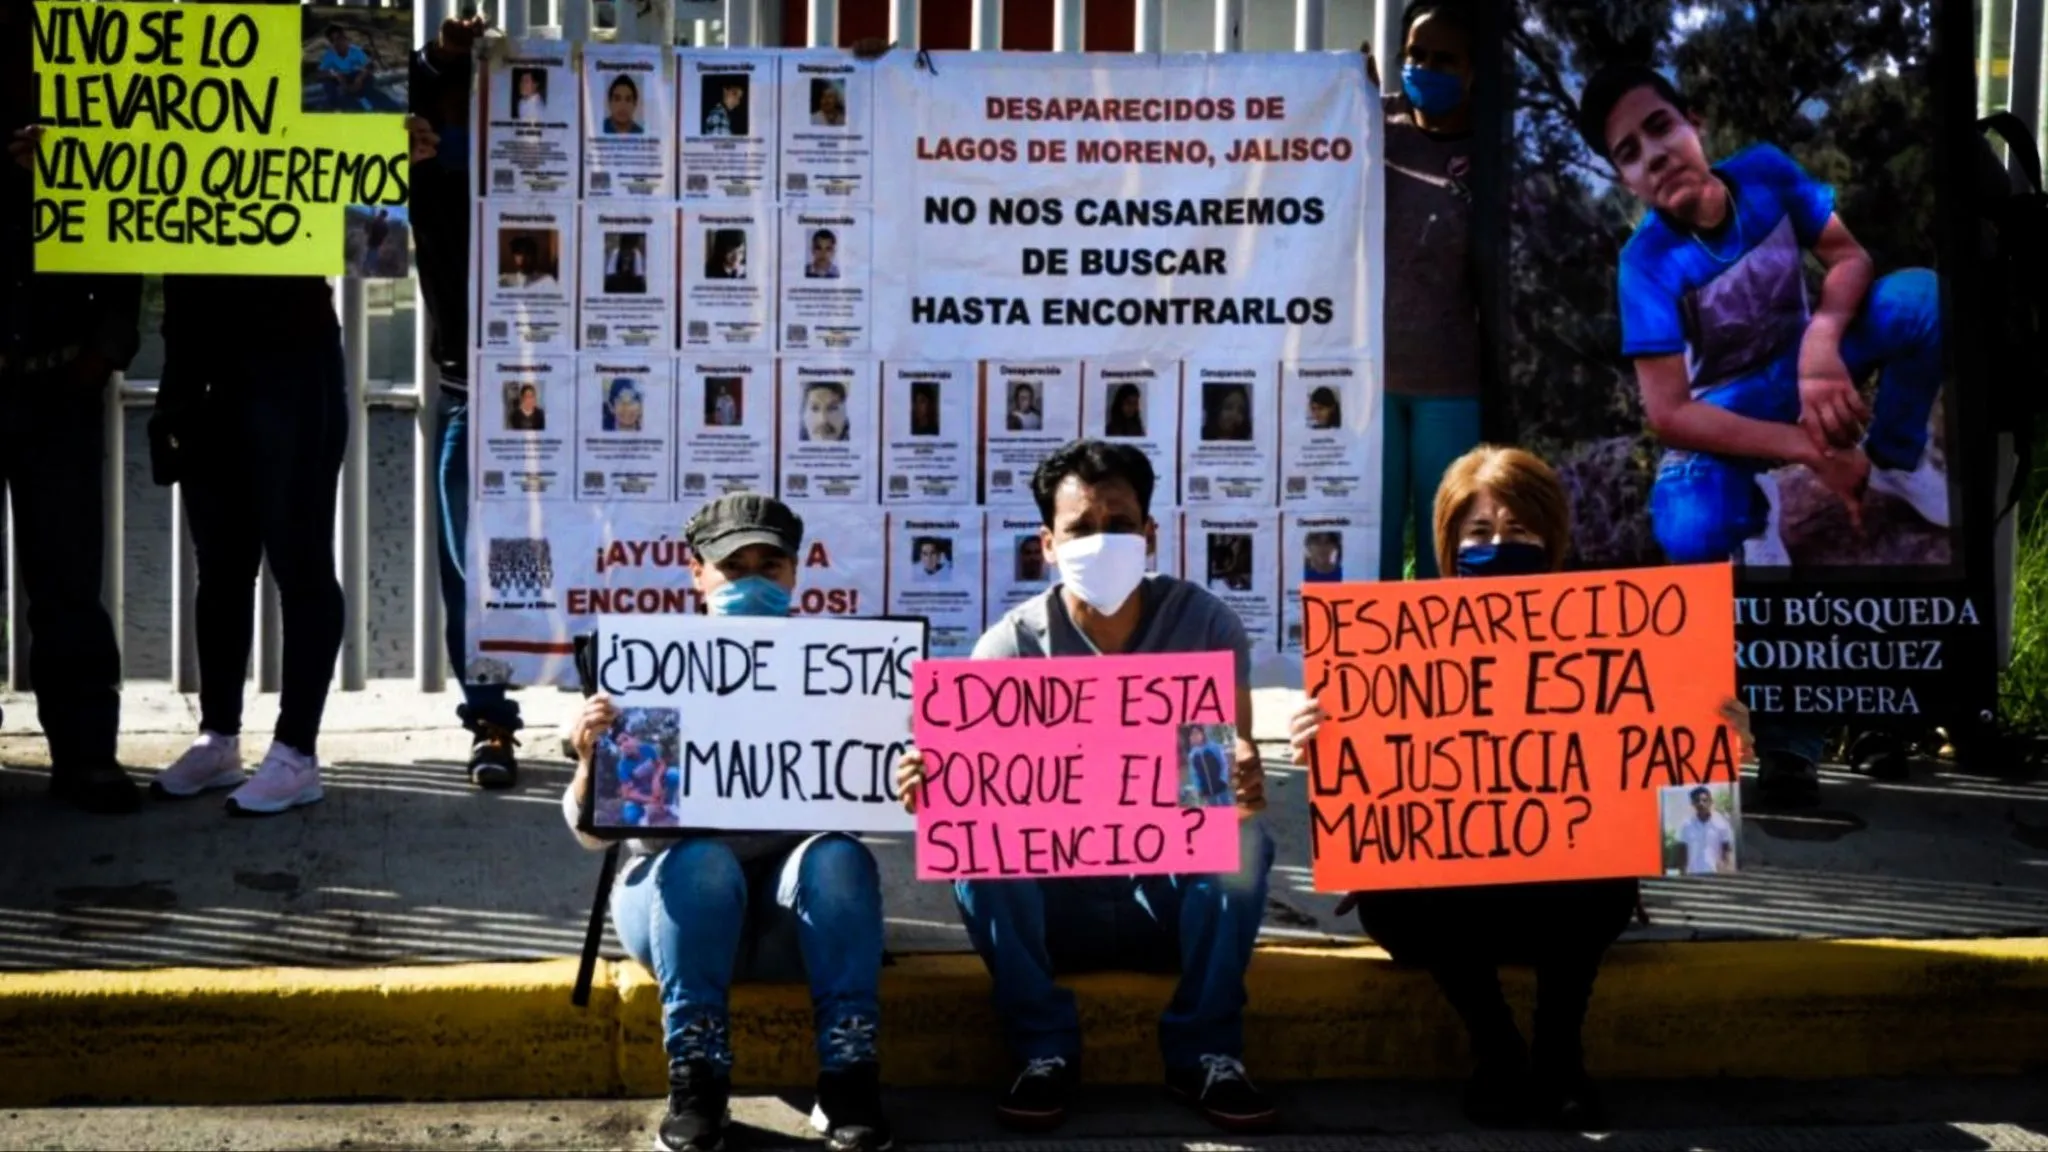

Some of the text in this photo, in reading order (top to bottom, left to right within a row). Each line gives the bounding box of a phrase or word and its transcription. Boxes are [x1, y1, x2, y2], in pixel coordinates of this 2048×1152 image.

[33, 5, 259, 68] VIVO SE LO
[986, 96, 1285, 122] DESAPARECIDOS DE
[34, 137, 409, 206] VIVO LO QUEREMOS
[916, 136, 1353, 168] LAGOS DE MORENO, JALISCO
[34, 198, 312, 247] DE REGRESO.
[924, 196, 1325, 227] NO NOS CANSAREMOS
[1022, 248, 1227, 276] DE BUSCAR
[910, 297, 1334, 327] HASTA ENCONTRARLOS
[805, 542, 829, 568] A
[1301, 580, 1687, 658] DESAPARECIDO
[1733, 591, 1980, 633] TU BÚSQUEDA
[600, 634, 918, 699] ¿DONDE ESTÁS
[1525, 648, 1656, 715] ESTA
[921, 670, 1226, 731] ¿DONDE ESTA
[1742, 685, 1921, 714] TE ESPERA
[683, 739, 915, 802] MAURICIO
[1117, 754, 1177, 808] EL
[1308, 724, 1737, 799] LA JUSTICIA PARA
